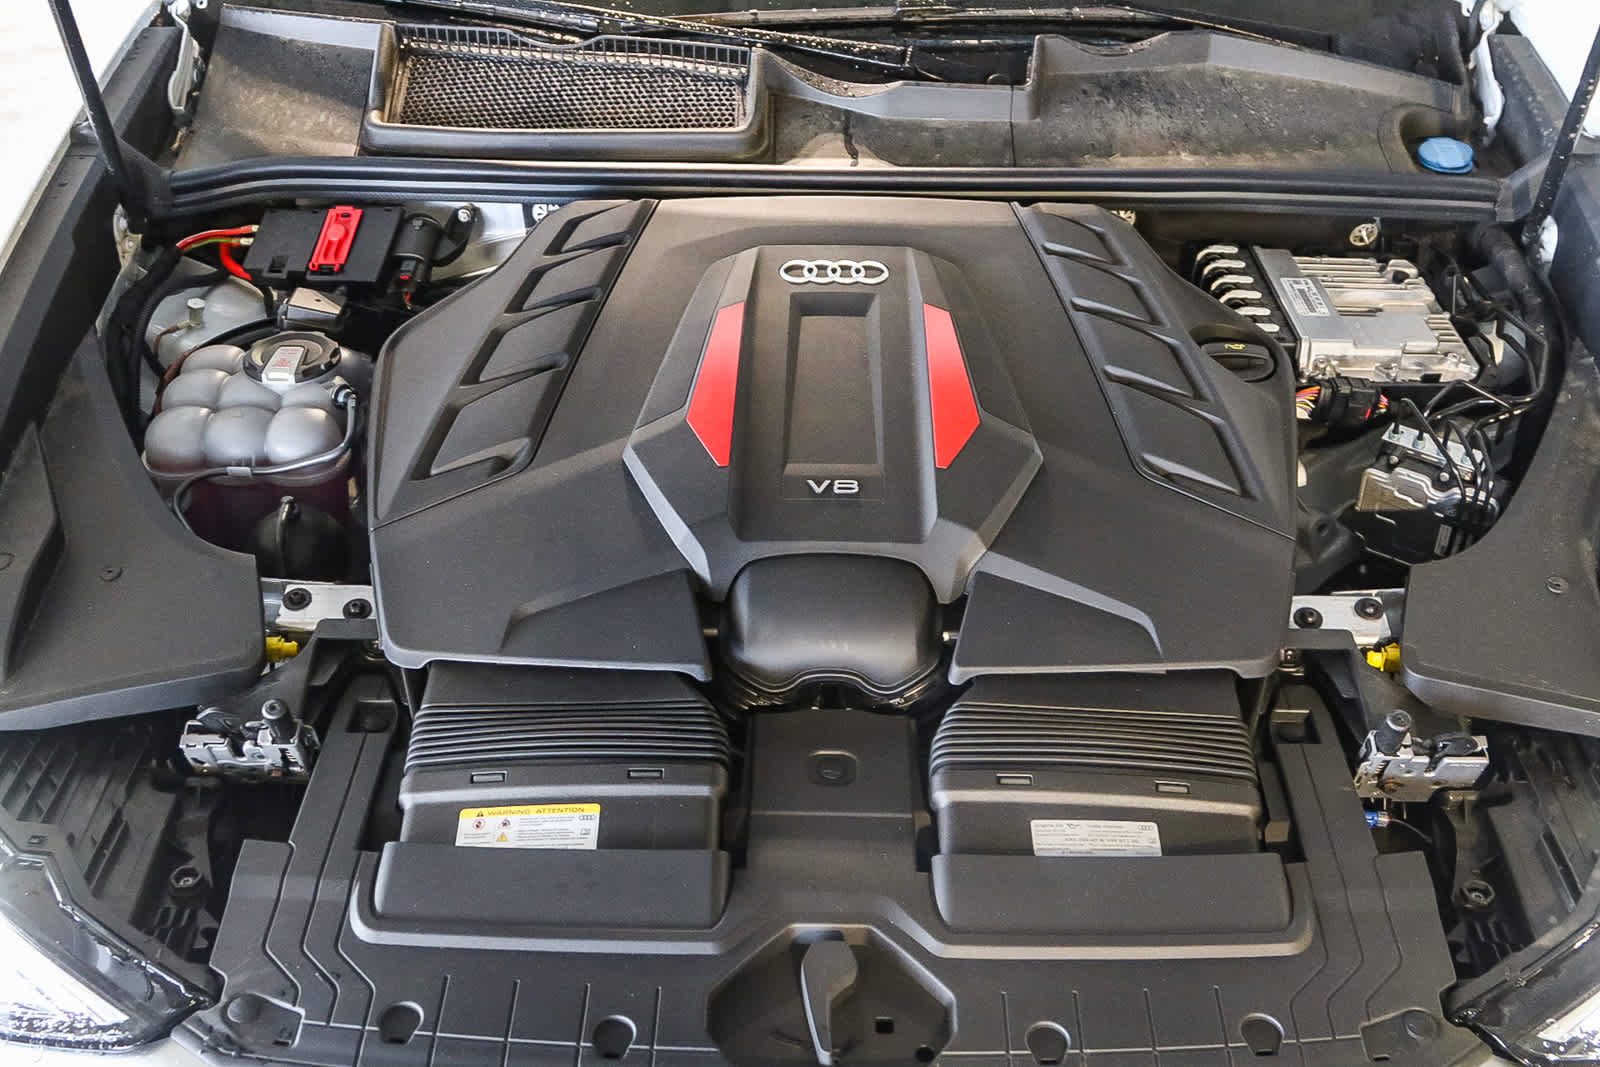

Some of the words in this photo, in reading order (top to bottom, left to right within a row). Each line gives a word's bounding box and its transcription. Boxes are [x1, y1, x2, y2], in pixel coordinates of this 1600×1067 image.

[806, 479, 860, 495] V8
[487, 808, 531, 816] WARNING
[535, 807, 585, 815] ATTENTION
